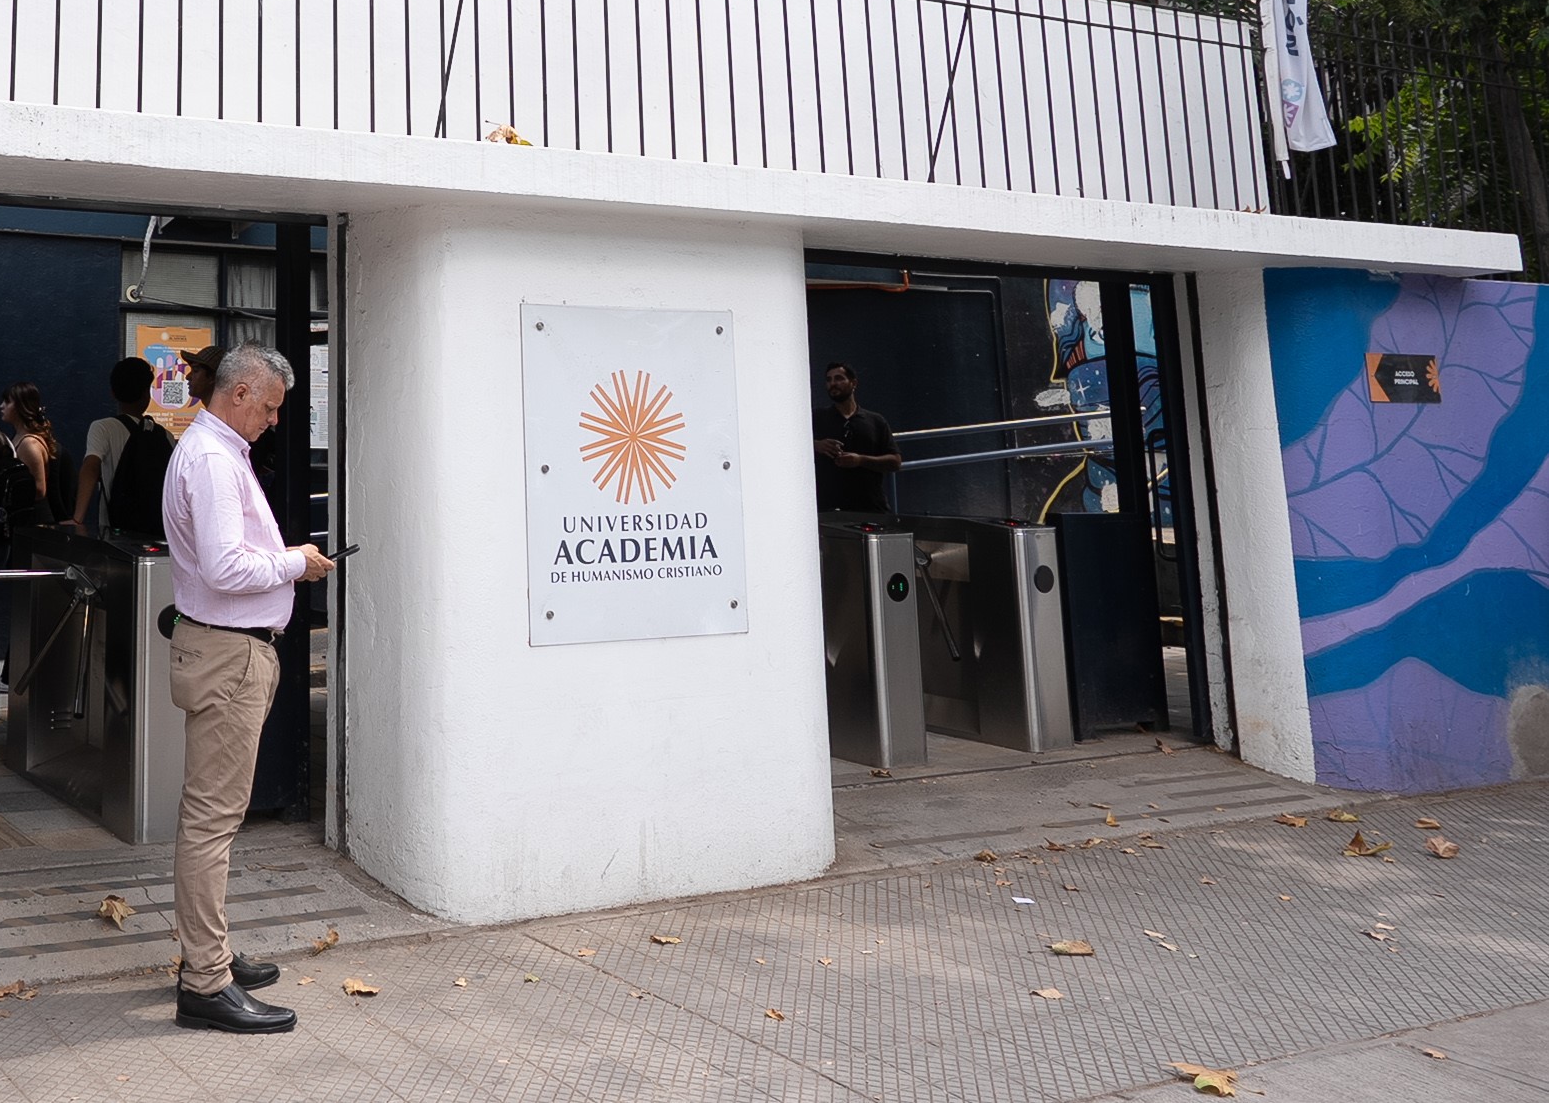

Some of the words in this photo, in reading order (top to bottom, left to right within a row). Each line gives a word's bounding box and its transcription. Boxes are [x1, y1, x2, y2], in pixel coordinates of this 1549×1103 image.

[1394, 370, 1416, 378] ACCESO
[1394, 378, 1420, 386] PRINCIPAL
[563, 512, 708, 534] UNIVERSIDAD
[553, 535, 719, 565] ACADEMIA
[550, 571, 567, 584] DE
[571, 568, 654, 583] HUMANISMO
[657, 564, 723, 579] CRISTIANO
